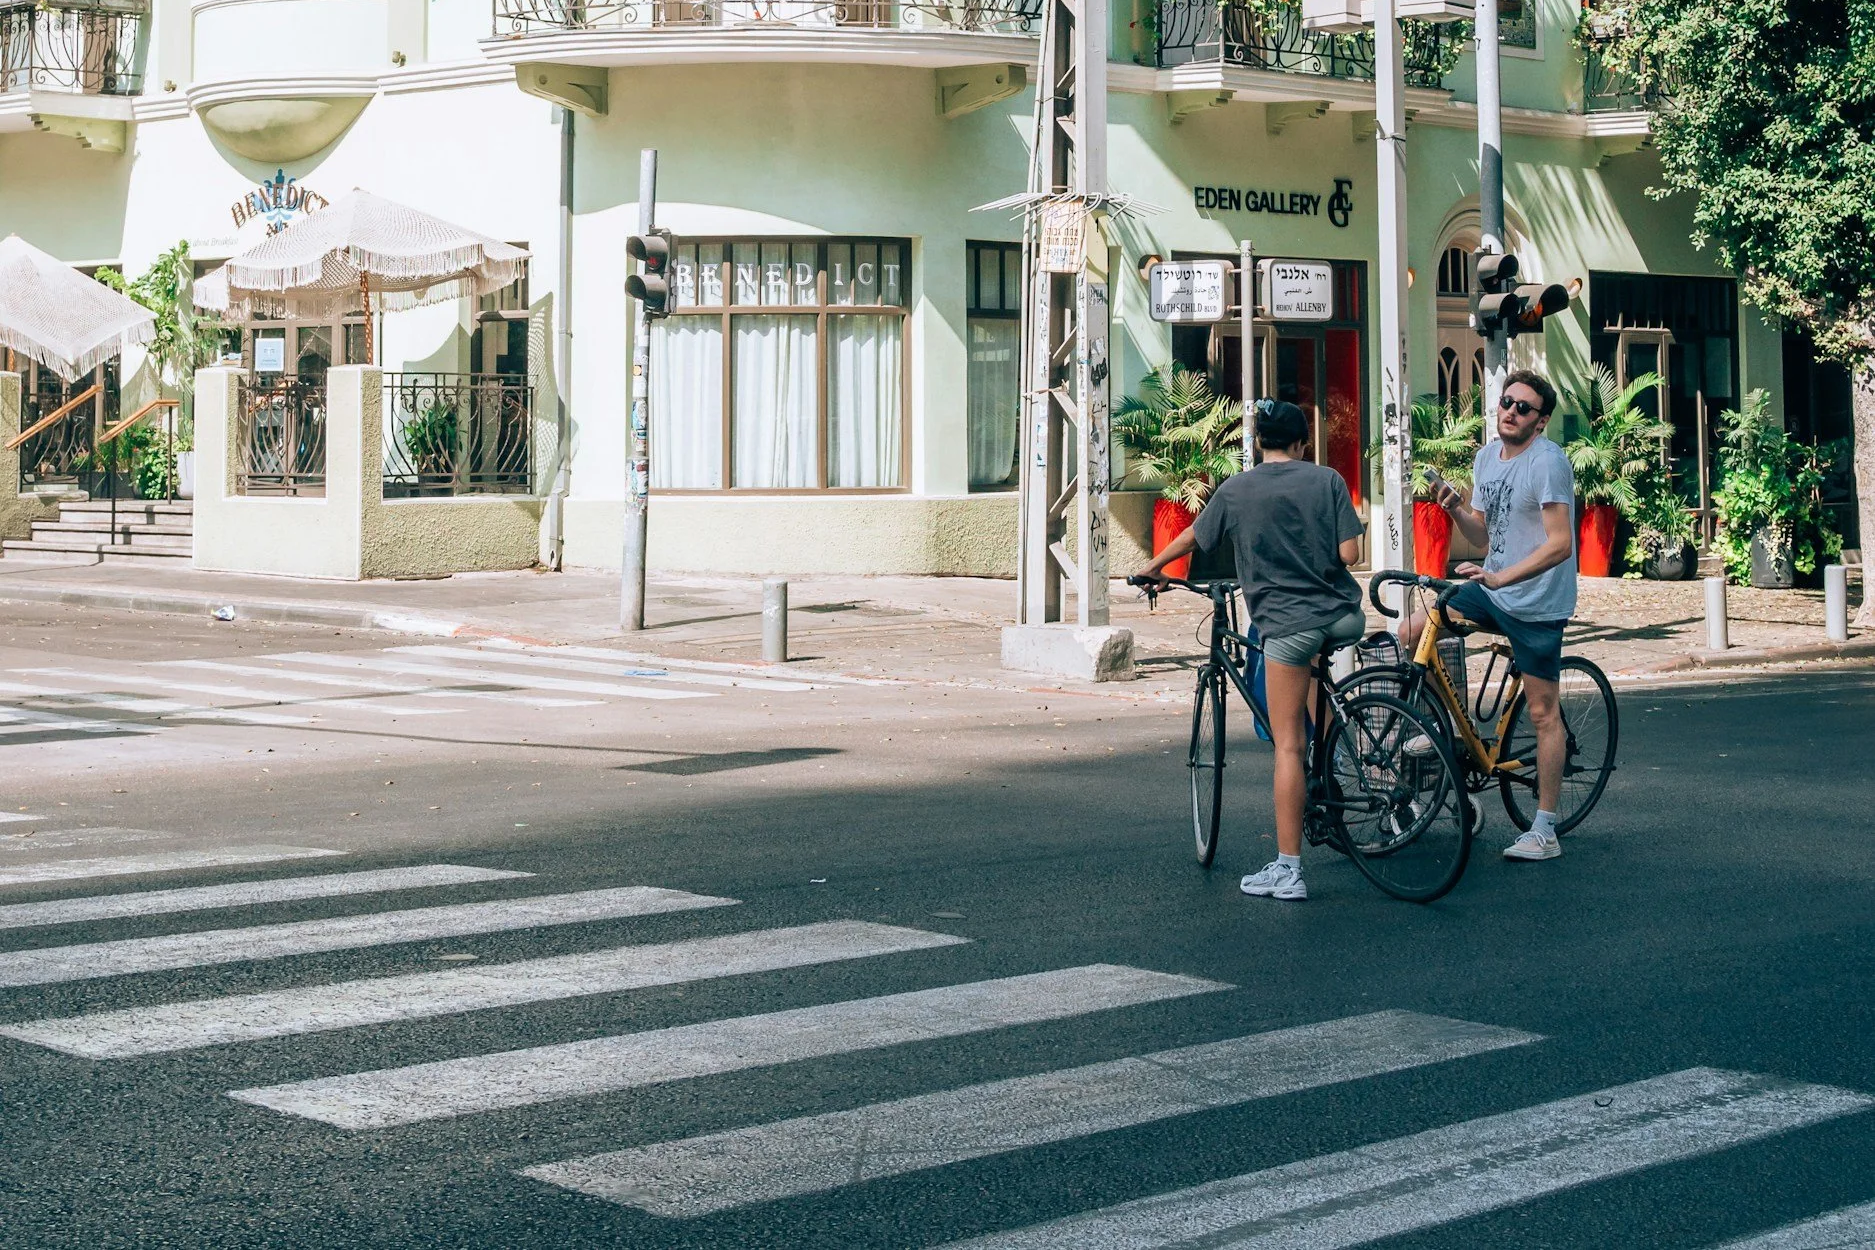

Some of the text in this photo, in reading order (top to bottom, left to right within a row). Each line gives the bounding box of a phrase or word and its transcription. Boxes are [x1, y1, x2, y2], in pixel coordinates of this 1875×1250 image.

[231, 183, 330, 229] BENEDICT
[1194, 186, 1321, 216] EDEN GALLERY
[676, 263, 900, 287] BENEDICT
[1156, 268, 1202, 281] רוטשילד
[1276, 266, 1309, 280] אלנבי
[1155, 302, 1203, 313] ROTHSCHILD
[1295, 302, 1327, 313] ALLENBY
